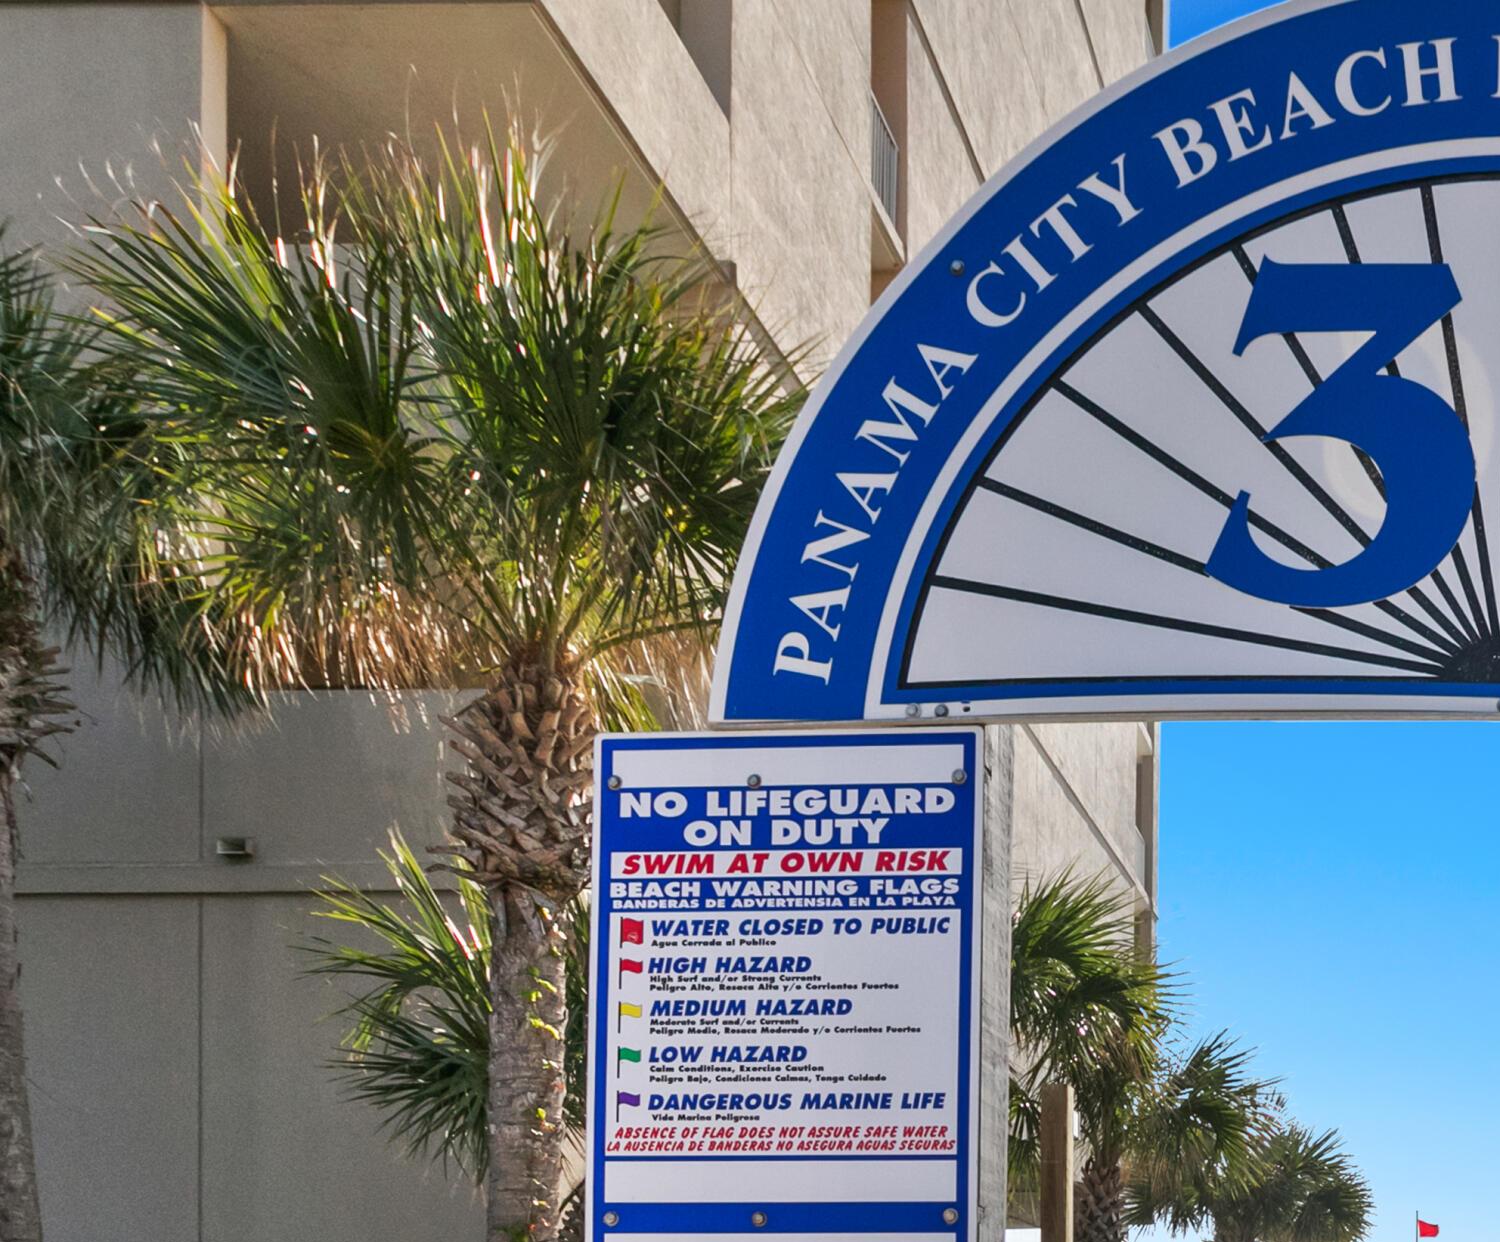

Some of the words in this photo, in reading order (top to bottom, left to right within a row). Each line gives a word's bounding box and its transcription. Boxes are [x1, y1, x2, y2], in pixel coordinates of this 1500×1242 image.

[773, 342, 979, 685] PANAMA
[966, 153, 1143, 327] CITY
[1151, 37, 1463, 189] BEACH
[619, 791, 687, 818] NO
[706, 787, 954, 816] LIFEGUARD
[683, 819, 751, 846] ON
[770, 817, 888, 845] DUTY
[622, 853, 714, 874] SWIM
[726, 852, 769, 873] AT
[780, 851, 863, 873] OWN
[874, 850, 949, 872] RISK
[609, 880, 700, 898] BEACH
[712, 879, 857, 896] WARNING
[869, 877, 959, 895] FLAGS
[612, 898, 699, 909] BANDERAS
[704, 898, 725, 908] DE
[731, 896, 842, 908] ADVERTENSIA
[848, 896, 870, 907] EN
[875, 896, 896, 906] LA
[901, 895, 955, 906] PLAYA
[651, 919, 729, 936] WATER
[738, 918, 823, 935] CLOSED
[832, 917, 862, 935] TO
[870, 916, 950, 934] PUBLIC
[647, 956, 706, 973] HIGH
[715, 955, 811, 973] HAZARD
[650, 999, 746, 1016] MEDIUM
[755, 998, 852, 1016] HAZARD
[648, 1045, 703, 1063] LOW
[710, 1045, 807, 1062] HAZARD
[649, 1064, 675, 1072] Calm
[677, 1064, 735, 1073] Conditions,
[738, 1063, 781, 1072] Exercise
[784, 1063, 824, 1072] Caution
[647, 1093, 791, 1110] DANGEROUS
[799, 1092, 892, 1110] MARINE
[900, 1091, 945, 1109] LIFE
[614, 1126, 676, 1139] ABSENCE
[680, 1126, 699, 1139] OF
[701, 1126, 734, 1139] FLAG
[737, 1125, 775, 1139] DOES
[778, 1125, 805, 1138] NOT
[806, 1125, 861, 1138] ASSURE
[863, 1125, 898, 1138] SAFE
[902, 1124, 948, 1138] WATER
[607, 1141, 620, 1151] LA
[624, 1141, 684, 1151] AUSENCIA
[688, 1141, 703, 1151] DE
[708, 1141, 773, 1151] BANDERAS
[776, 1140, 793, 1151] NO
[797, 1140, 853, 1151] ASEGURA
[856, 1140, 897, 1150] AGUAS
[899, 1140, 956, 1150] SEGURAS
